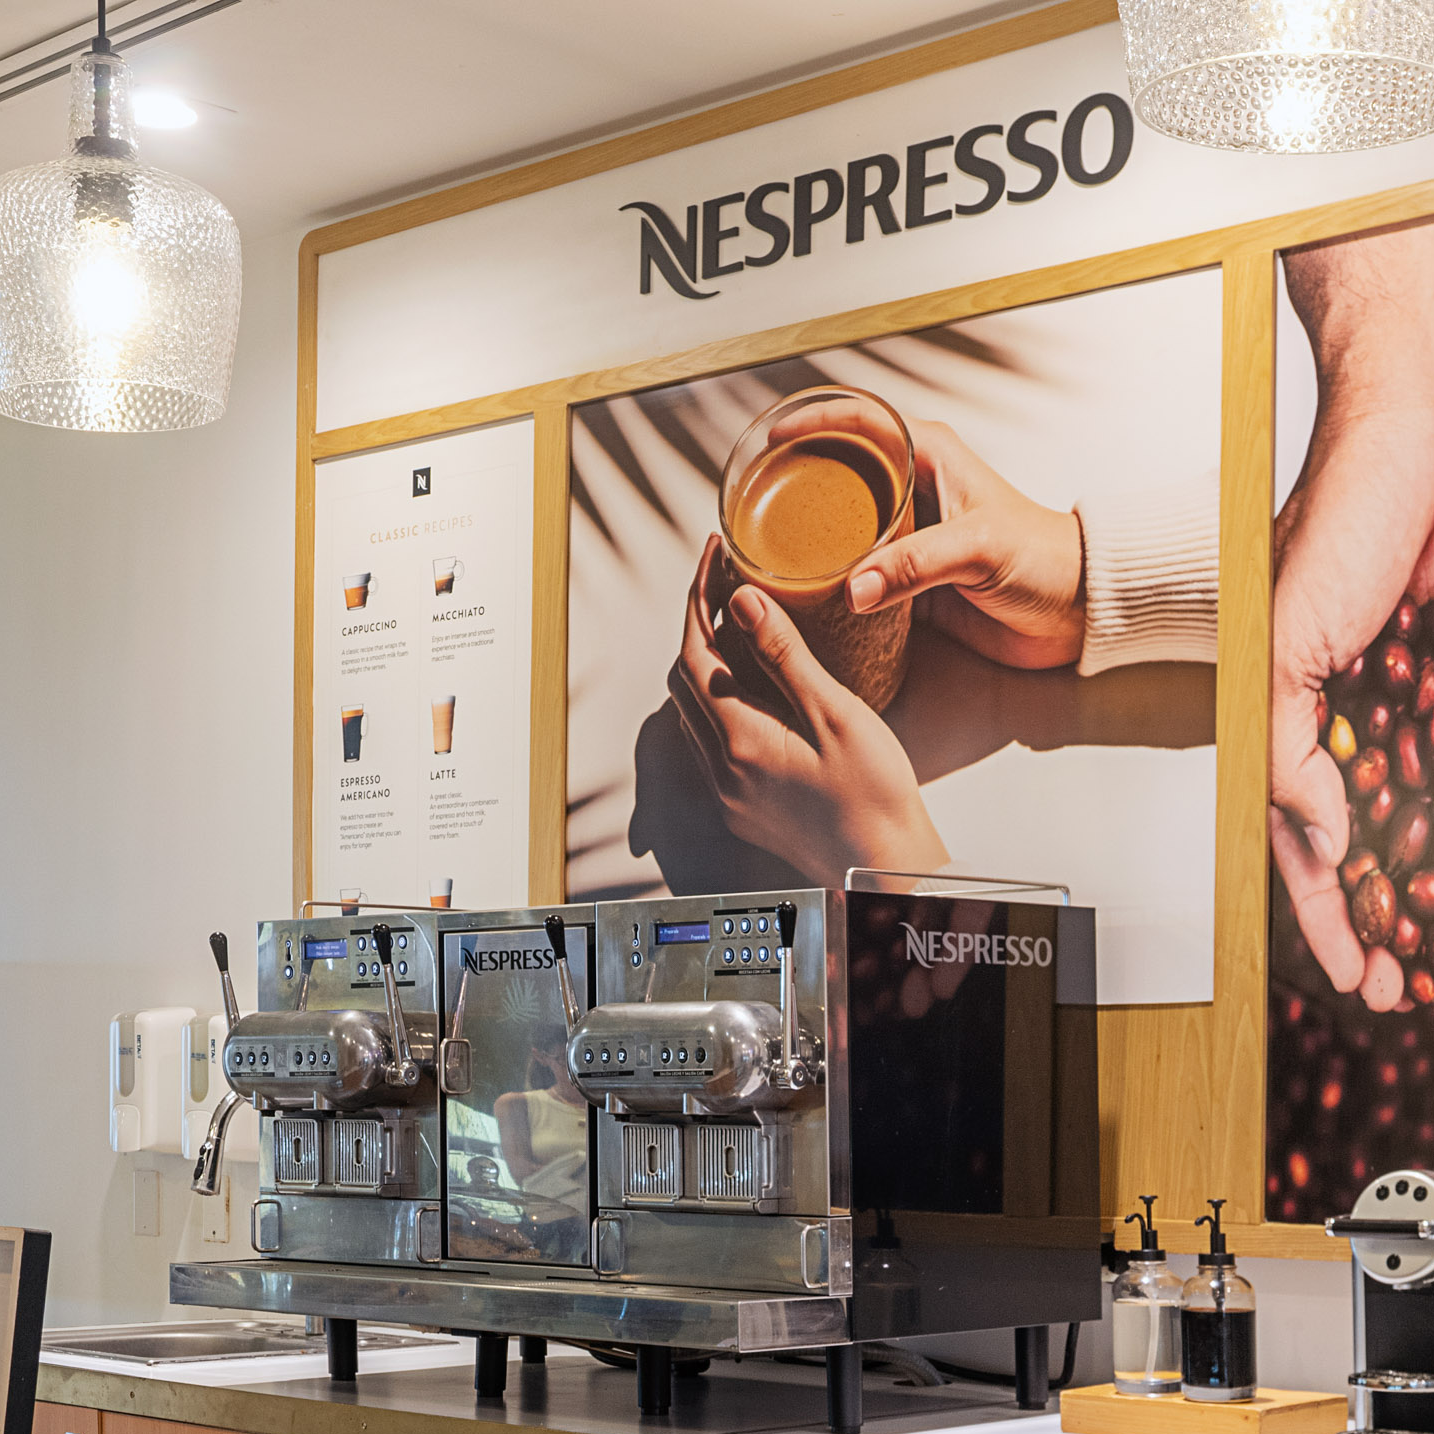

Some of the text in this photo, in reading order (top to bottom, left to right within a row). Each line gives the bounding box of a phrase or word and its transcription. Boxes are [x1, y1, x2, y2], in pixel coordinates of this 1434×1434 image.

[618, 92, 1135, 300] NESPRESSO
[370, 514, 473, 544] CLASSIC RECIPES
[432, 606, 485, 623] MACCHIATO
[341, 619, 397, 637] CAPPUCCINO
[340, 774, 381, 788] ESPRESSO
[430, 768, 456, 780] LATTE
[340, 788, 391, 802] AMERICANO
[898, 922, 1053, 969] NESPRESSO
[461, 947, 557, 976] NESPRESS
